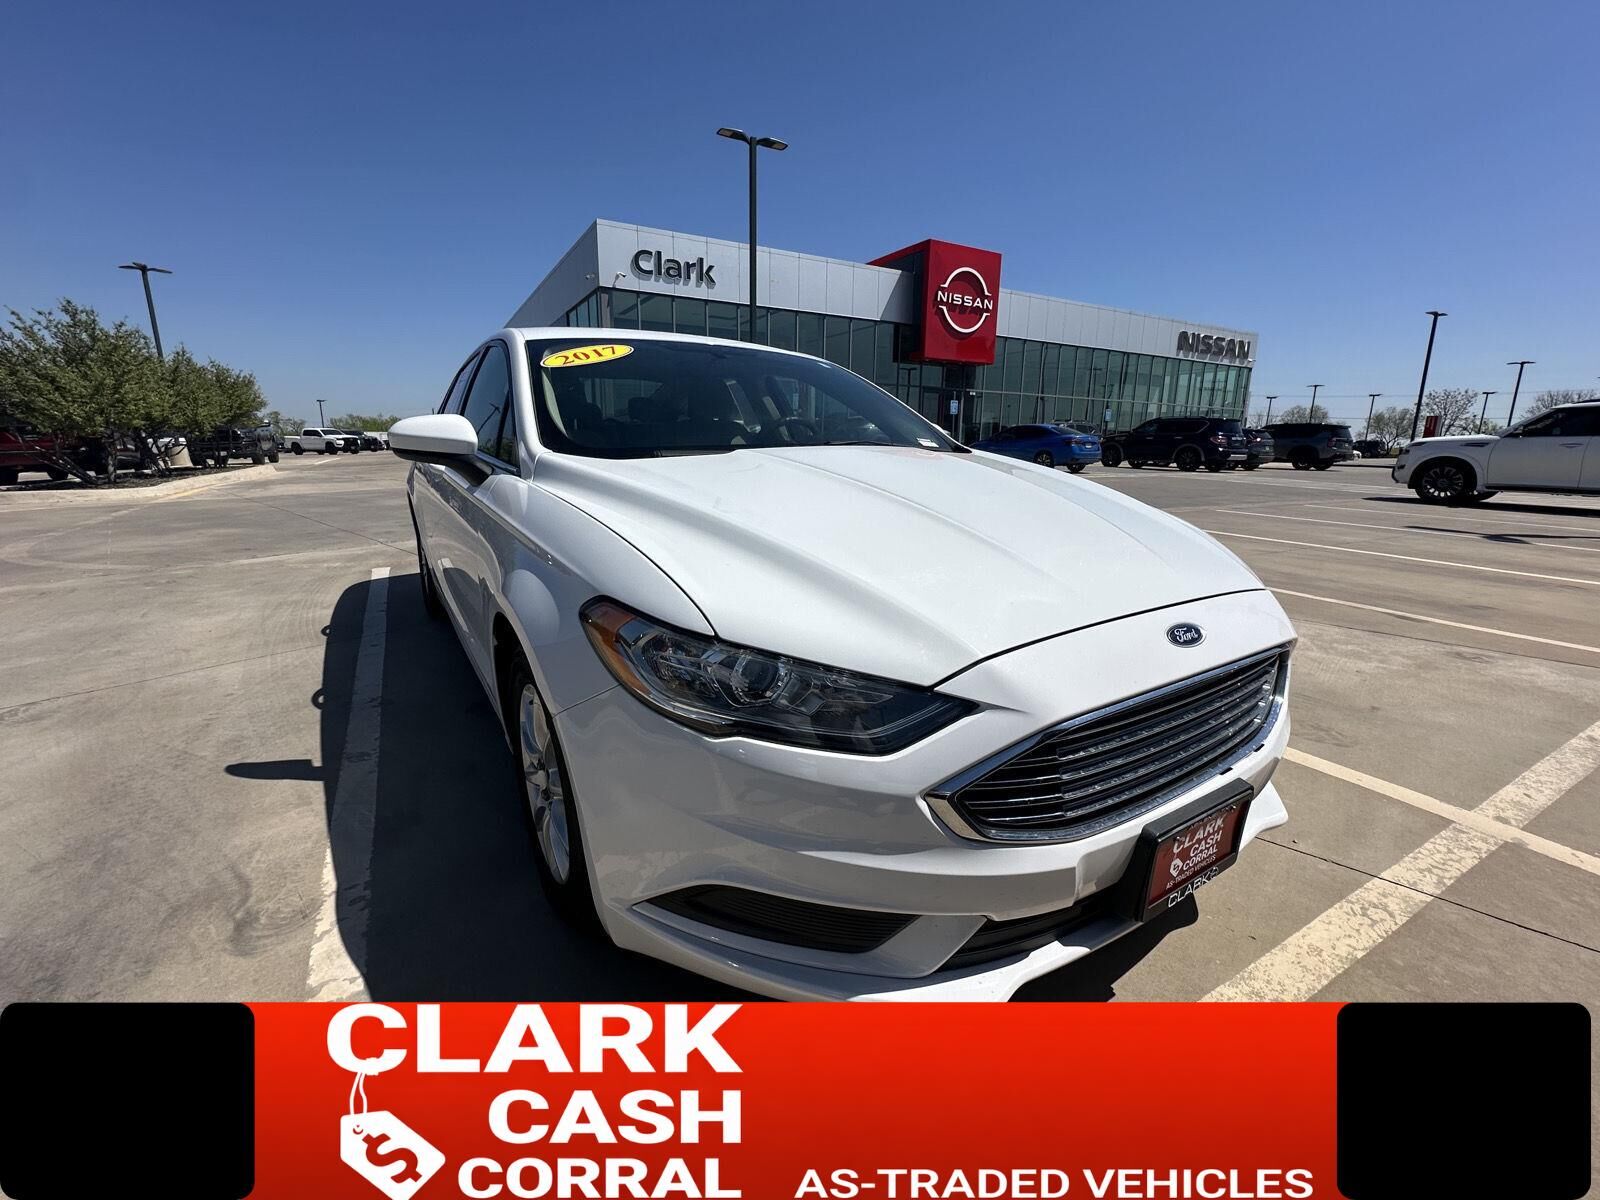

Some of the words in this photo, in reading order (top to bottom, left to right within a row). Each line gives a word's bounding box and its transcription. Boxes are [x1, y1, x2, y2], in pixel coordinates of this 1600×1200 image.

[630, 249, 716, 288] Clark
[937, 290, 993, 310] NISSAN
[554, 346, 616, 365] 2017
[1177, 330, 1251, 360] NISSAN
[1174, 627, 1199, 642] Ford
[1173, 813, 1226, 853] CLARK
[1190, 830, 1222, 857] CASH
[1183, 845, 1218, 870] CORRAL
